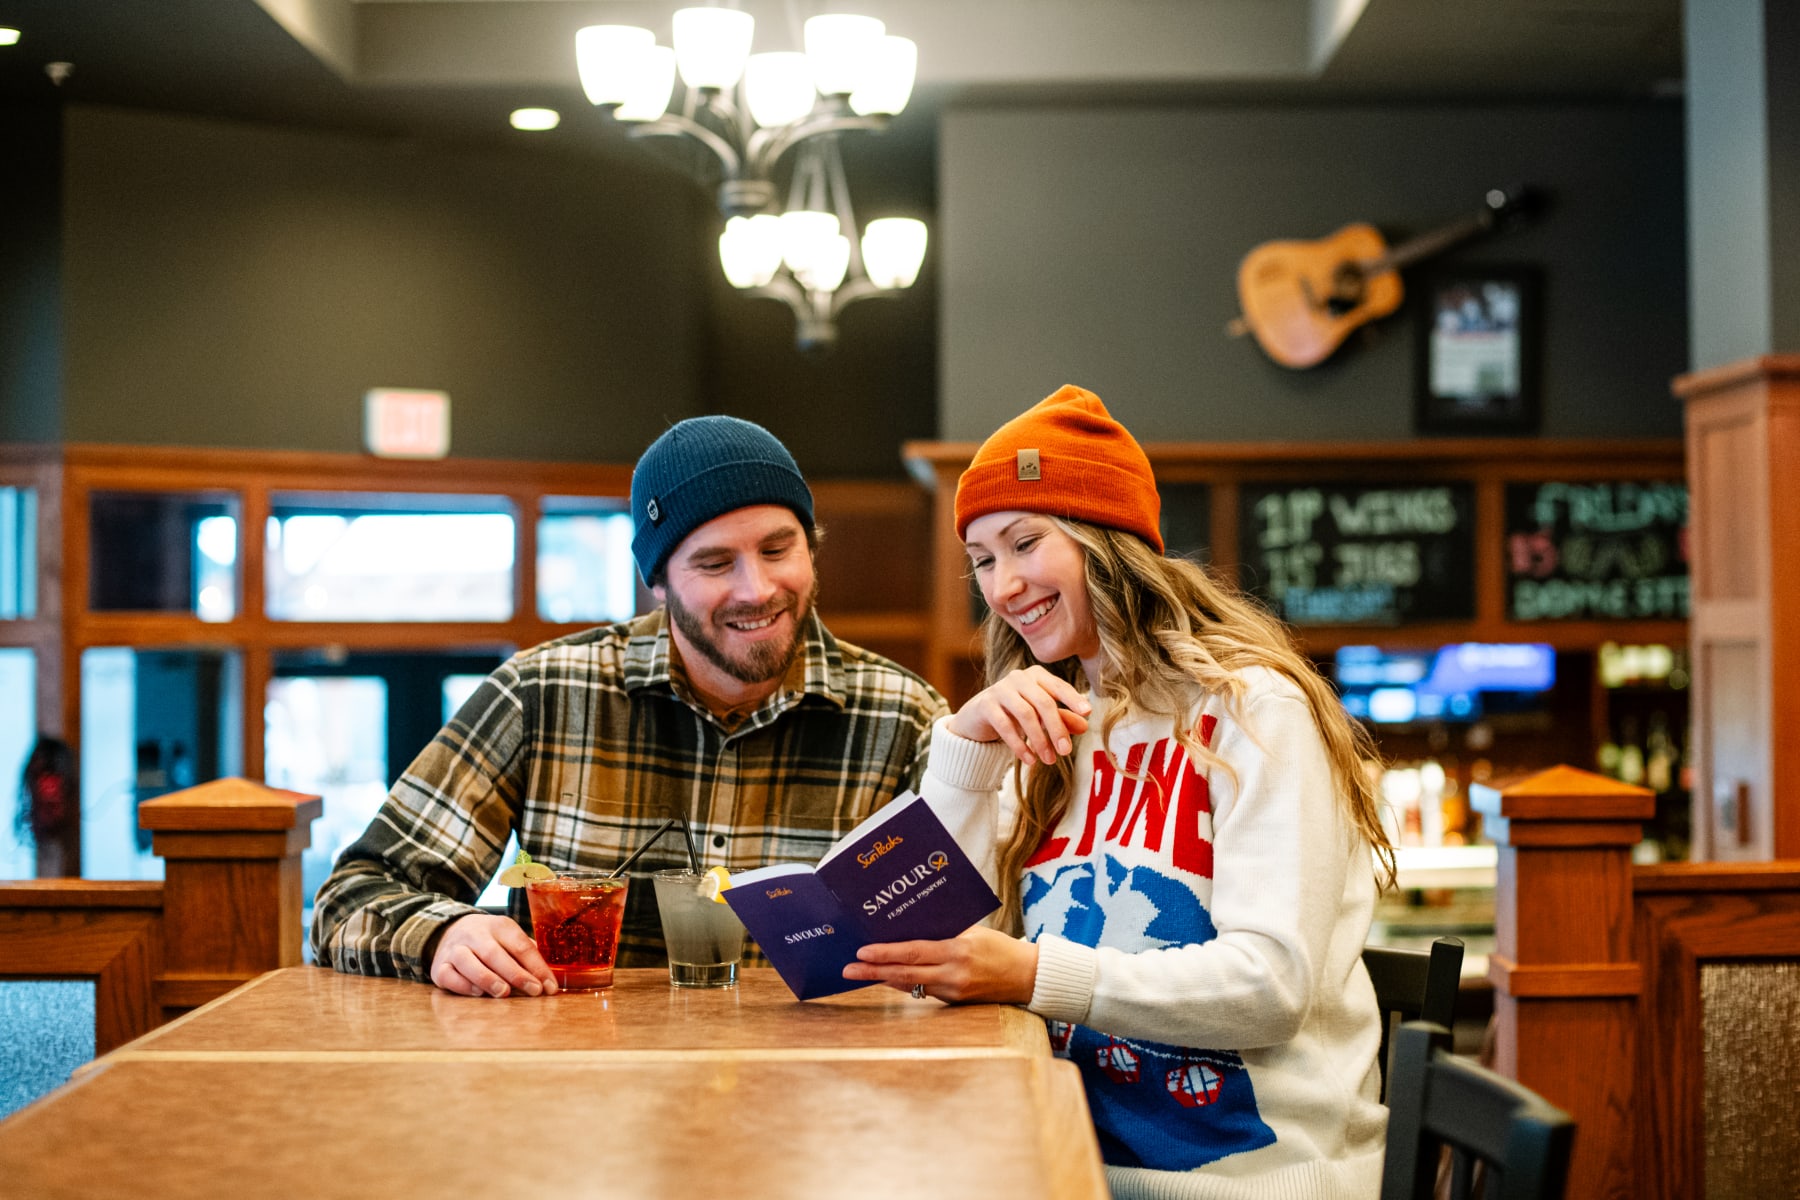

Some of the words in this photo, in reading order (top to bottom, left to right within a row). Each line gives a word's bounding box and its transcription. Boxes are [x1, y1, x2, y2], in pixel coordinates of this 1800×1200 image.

[862, 864, 933, 916] SAVOUR
[887, 897, 917, 921] FESTIVAL
[916, 876, 948, 900] PASSPORT
[784, 927, 825, 945] SAVOUR
